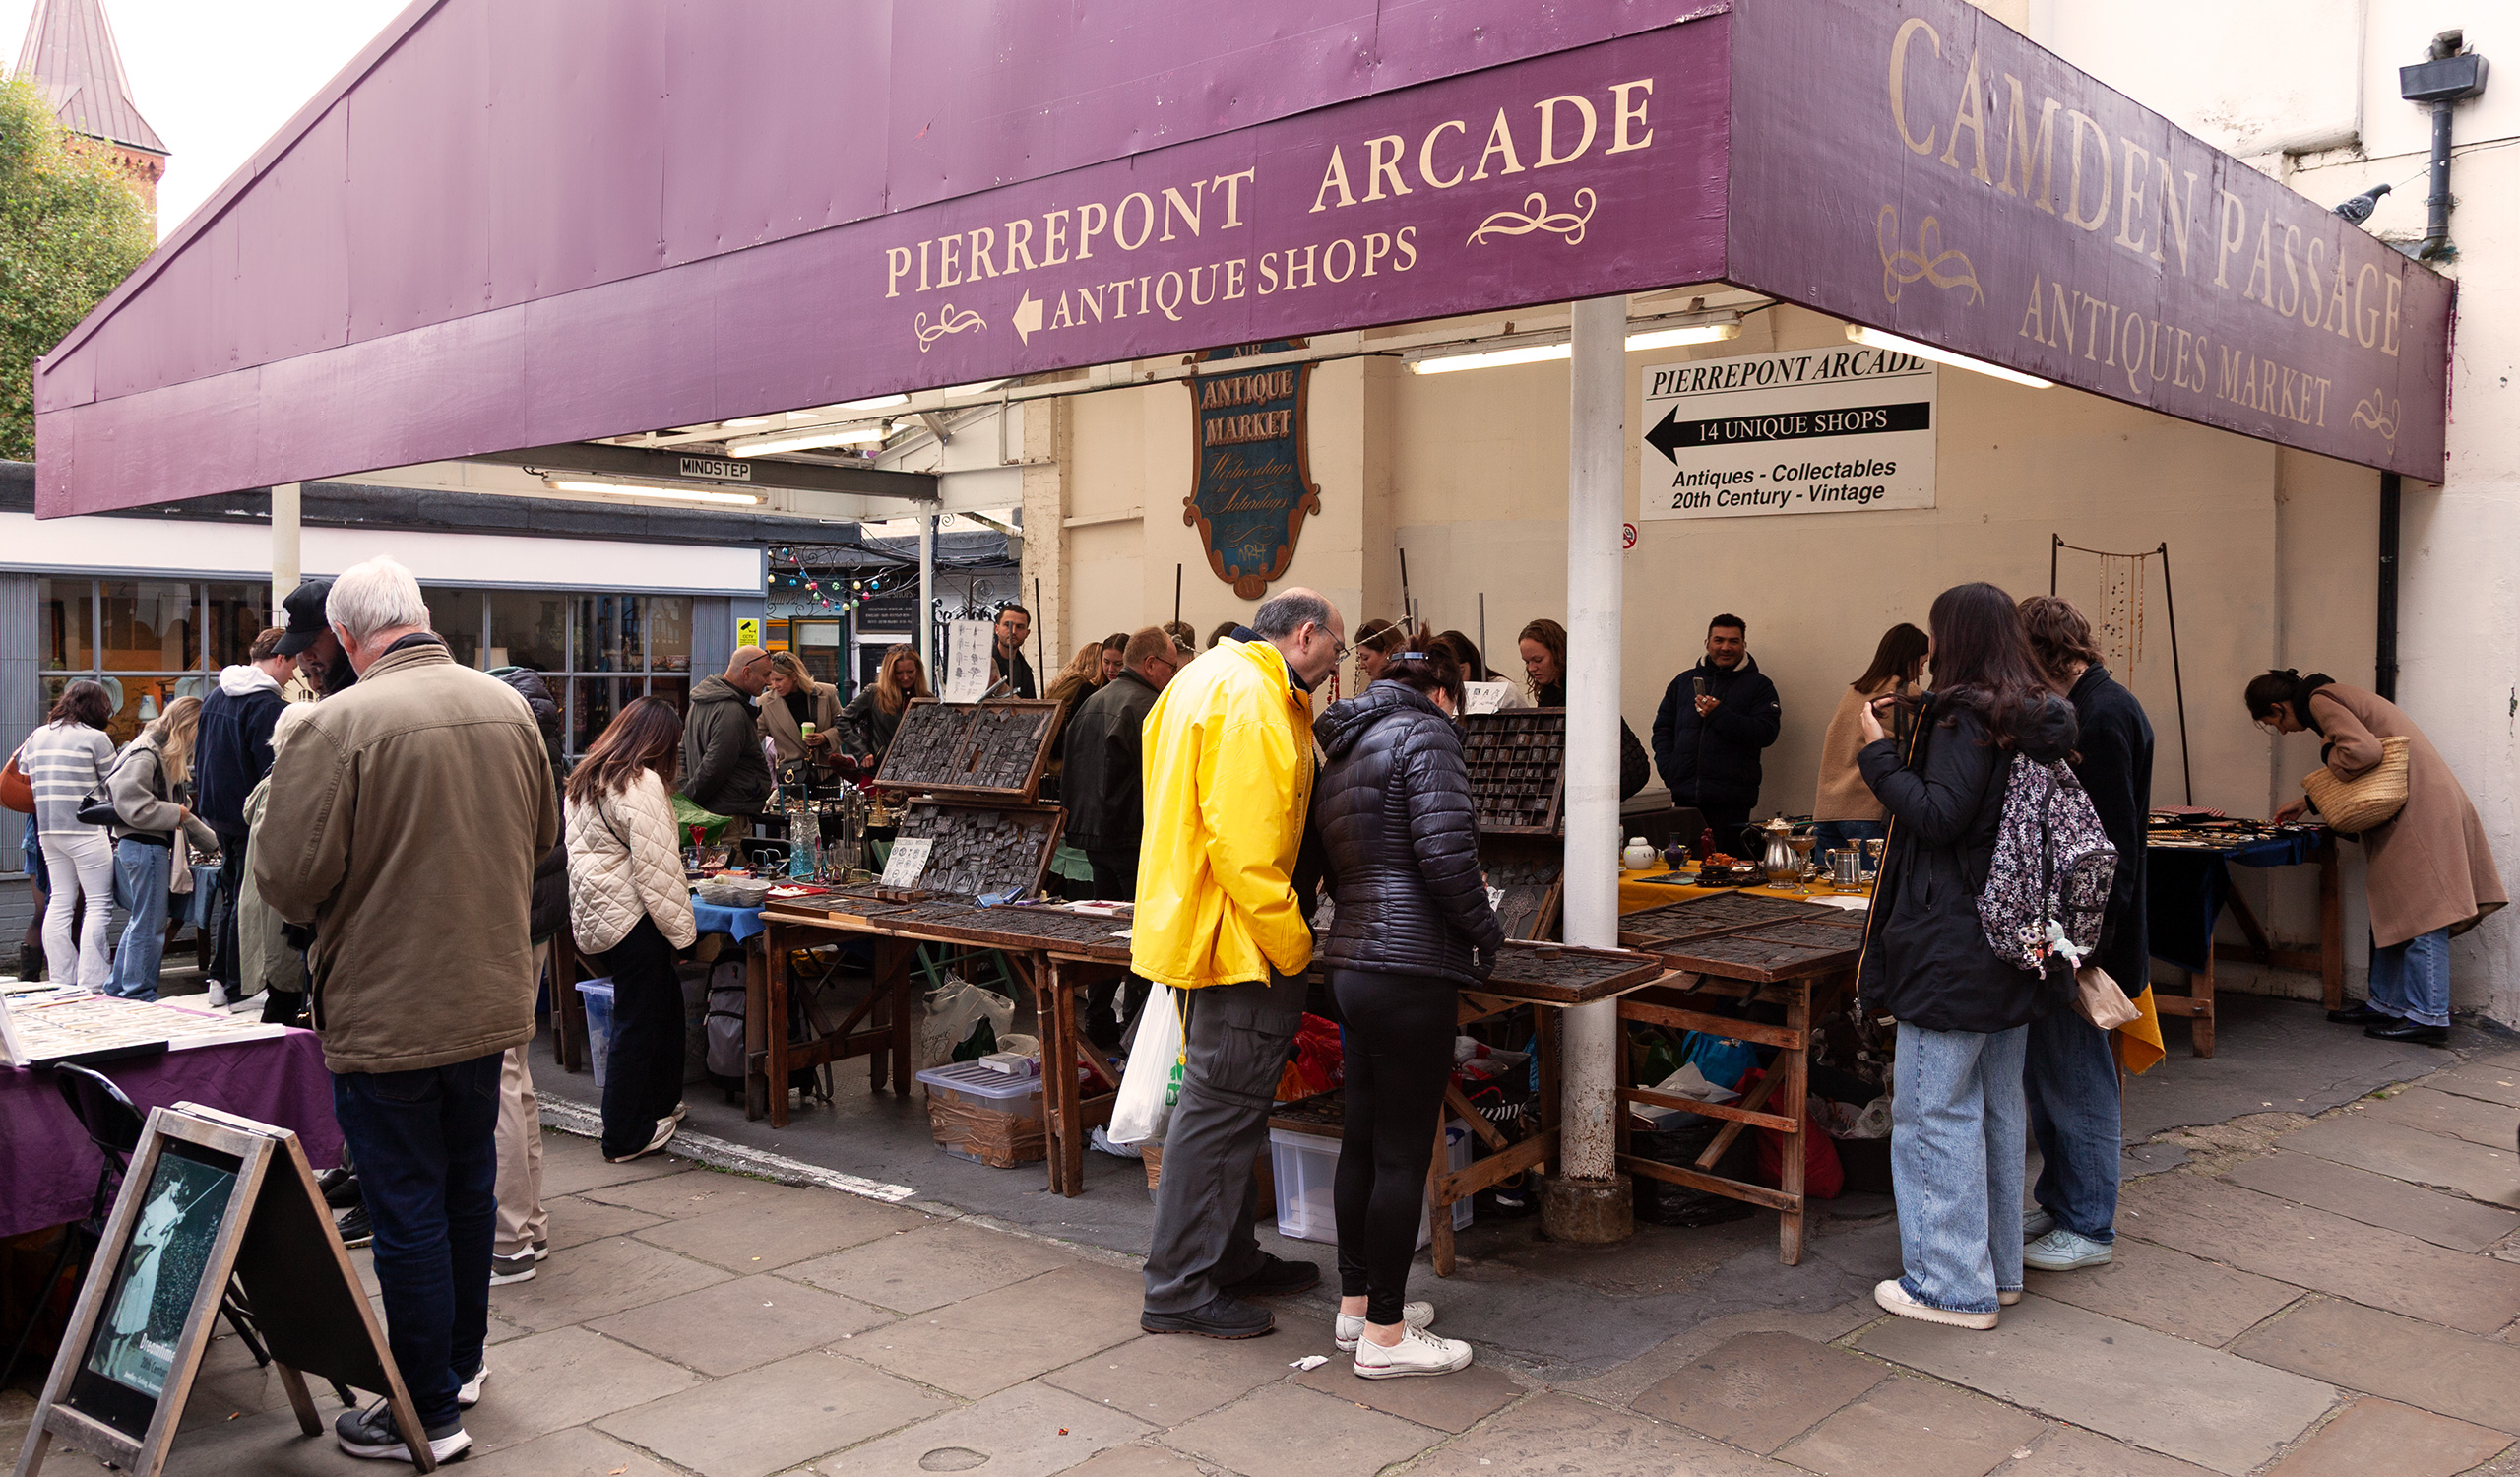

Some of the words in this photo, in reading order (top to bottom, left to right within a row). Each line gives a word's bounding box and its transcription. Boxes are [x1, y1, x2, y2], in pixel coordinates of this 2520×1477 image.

[885, 166, 1256, 299] PIERREPONT
[1309, 78, 1656, 214] ARCADE
[1889, 18, 2197, 278] CAMDEN
[2214, 188, 2402, 357] PASSAGE
[1050, 259, 1247, 330] ANTIQUE
[1257, 226, 1418, 296] SHOPS
[2018, 273, 2207, 394] ANTIQUES
[2216, 344, 2331, 427] MARKET
[1201, 370, 1294, 410] ANTIQUE
[1651, 356, 1811, 395] PIERREPONT
[1812, 350, 1925, 378] ARCADE
[1205, 410, 1292, 446] MARKET
[1699, 423, 1719, 441] 14
[1725, 416, 1808, 440] UNIQUE
[1814, 410, 1887, 433] SHOPS
[682, 459, 748, 477] MINDSTEP
[1206, 452, 1292, 482] Wednesdays
[1672, 470, 1754, 488] Antiques
[1772, 459, 1896, 482] Collectables
[1203, 483, 1289, 517] Saturdays
[1671, 491, 1711, 509] 20th
[1716, 486, 1791, 508] Century
[1808, 482, 1885, 504] Vintage
